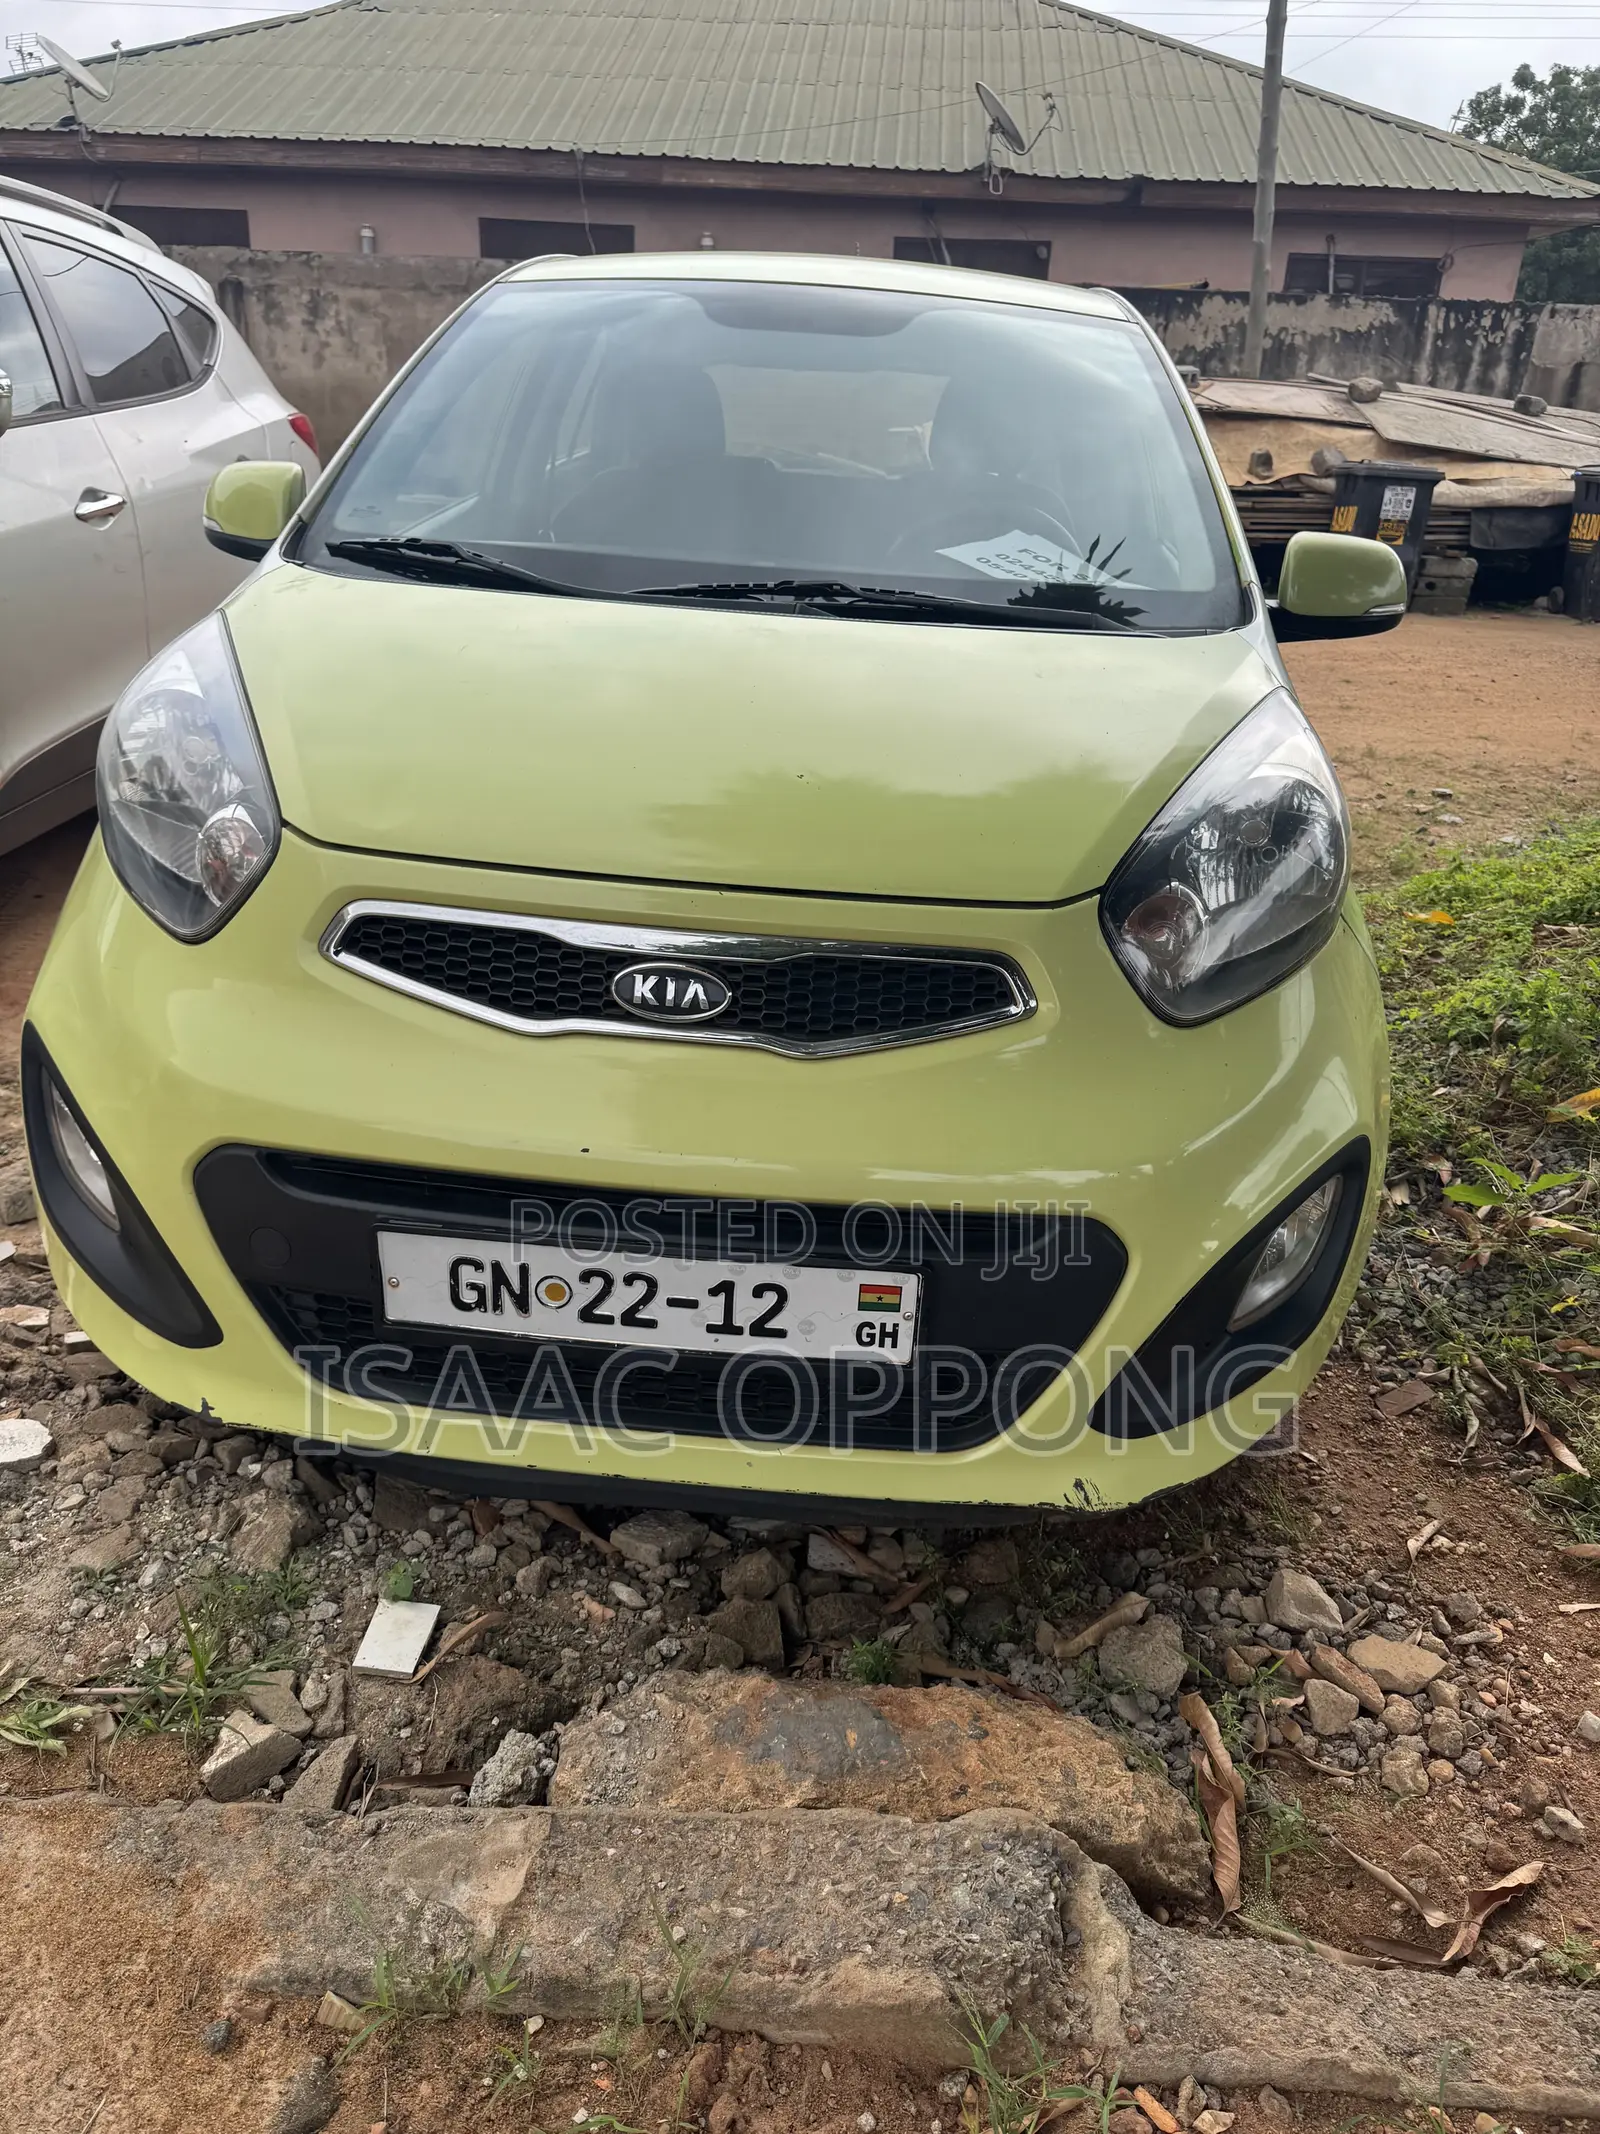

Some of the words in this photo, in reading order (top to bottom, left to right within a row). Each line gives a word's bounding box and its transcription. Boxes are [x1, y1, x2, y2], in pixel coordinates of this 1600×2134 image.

[633, 974, 710, 1010] KIA
[449, 1255, 531, 1316] GN
[577, 1268, 788, 1339] 22-12
[855, 1321, 900, 1349] GH
